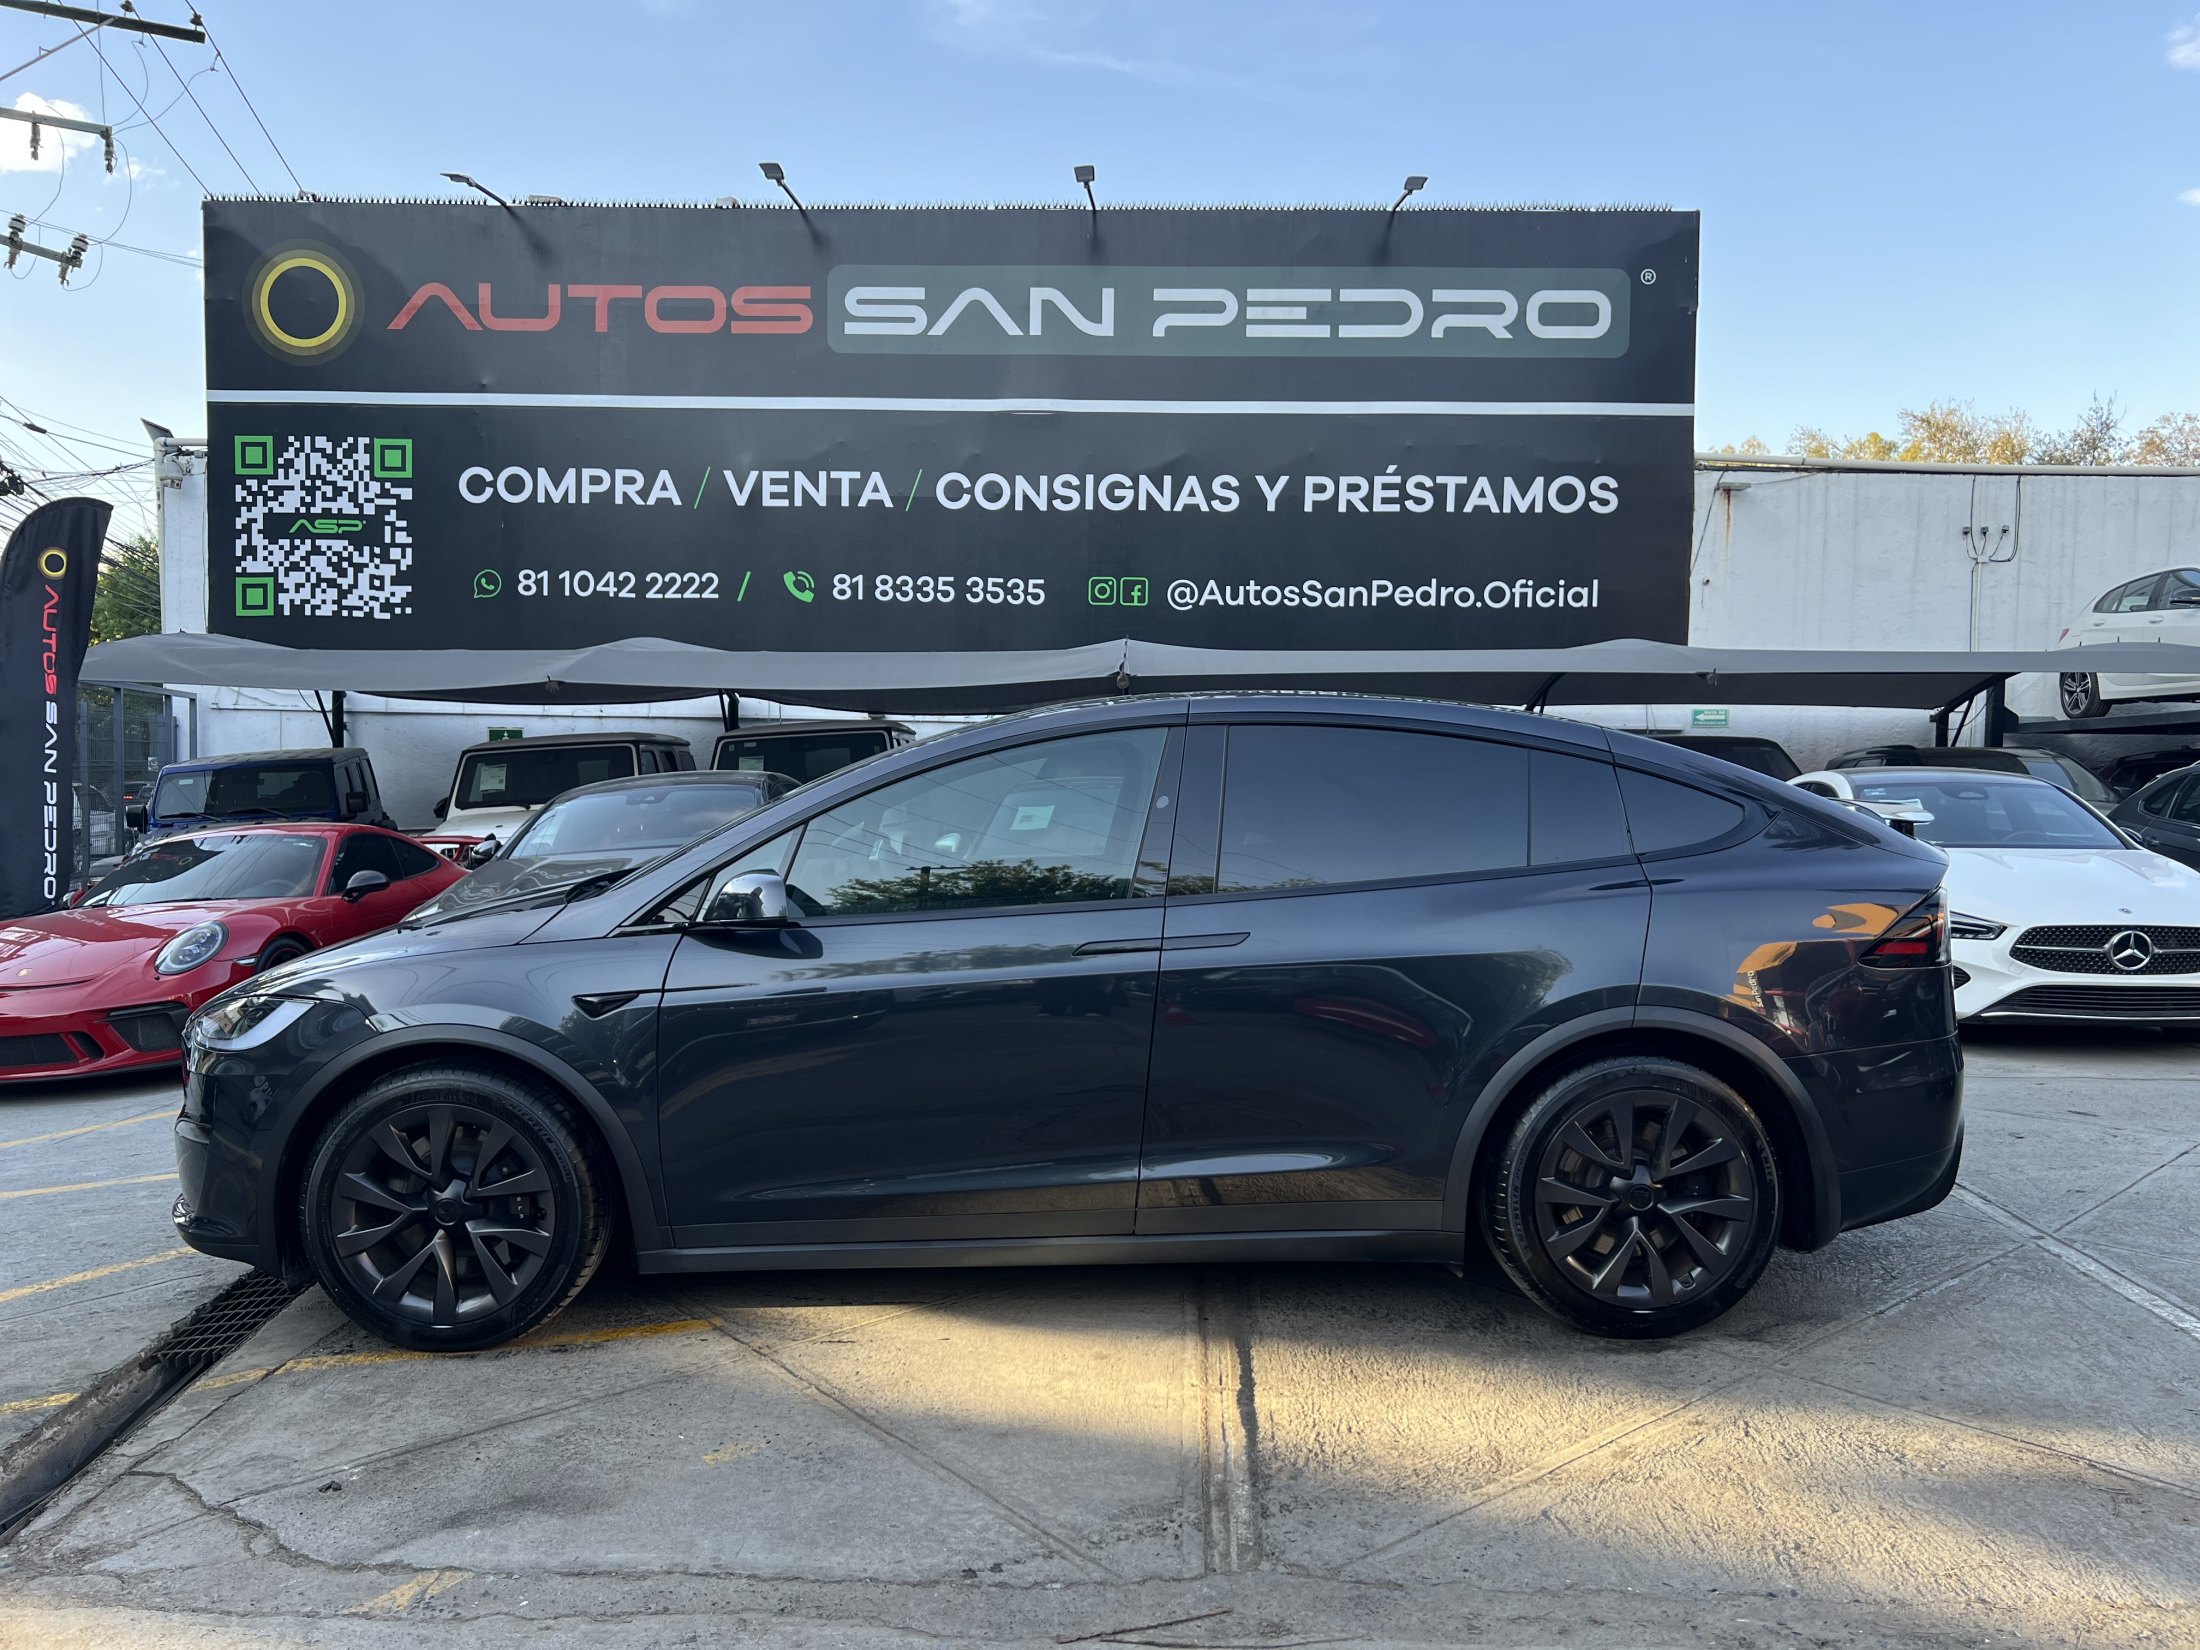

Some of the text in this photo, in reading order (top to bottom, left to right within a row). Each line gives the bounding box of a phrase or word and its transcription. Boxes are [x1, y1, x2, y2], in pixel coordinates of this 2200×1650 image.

[387, 282, 812, 334] AUTOS
[843, 286, 1116, 338] SAN
[1153, 288, 1613, 340] PEDRO
[458, 466, 683, 507] COMPRA
[723, 469, 895, 508] VENTA
[935, 472, 1241, 514] CONSIGNAS
[1256, 475, 1290, 512] Y
[1303, 464, 1620, 515] PRÉSTAMOS
[517, 570, 549, 597] 81
[559, 571, 637, 599] 1042
[646, 573, 720, 600] 2222
[832, 573, 1047, 607] 81 8335 3535
[1166, 578, 1600, 612] @AutosSanPedro.Oficial
[42, 584, 60, 899] AUTOS SAN PEDRO
